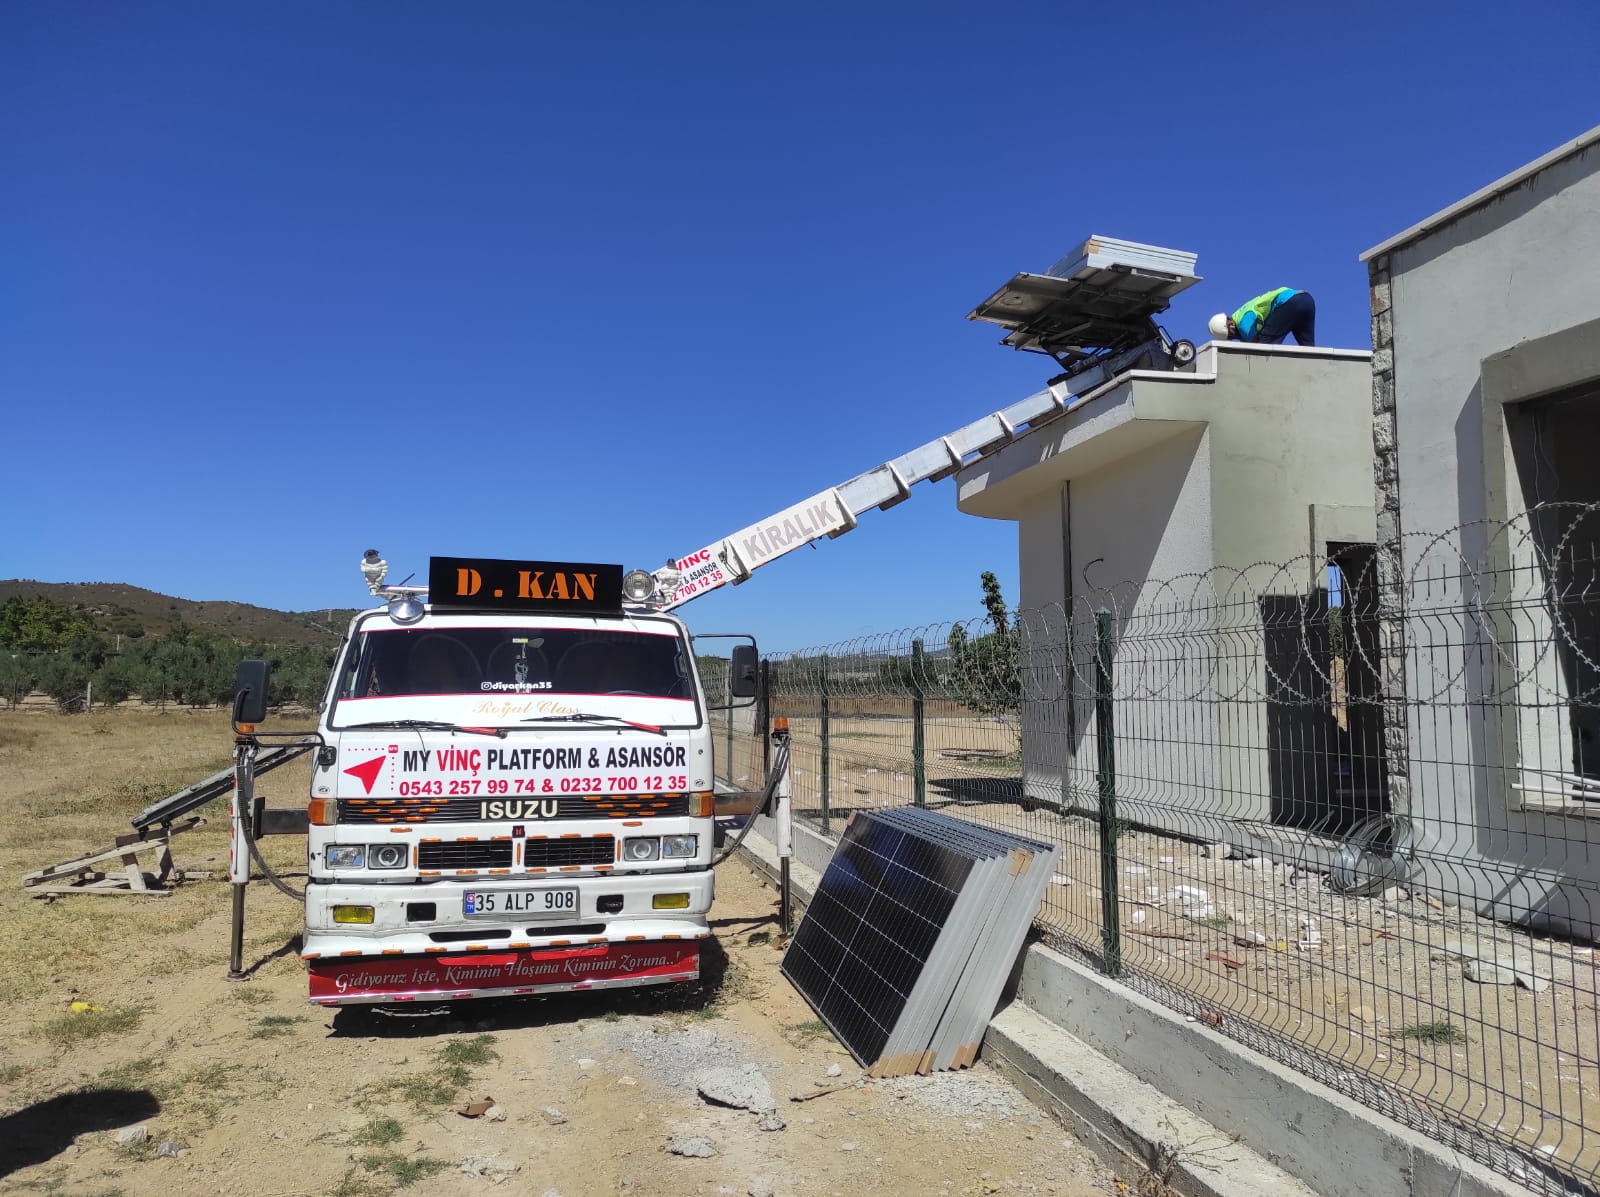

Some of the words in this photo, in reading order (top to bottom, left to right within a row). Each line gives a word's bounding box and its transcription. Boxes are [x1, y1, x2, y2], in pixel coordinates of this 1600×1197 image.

[742, 499, 837, 562] KİRALIK
[517, 570, 598, 601] KAN
[679, 583, 697, 598] 700
[698, 576, 711, 589] 12
[710, 570, 723, 582] 35
[472, 701, 533, 718] Royal
[536, 701, 583, 715] Class
[403, 749, 431, 772] MY
[436, 744, 482, 777] VİNÇ
[487, 747, 582, 771] PLATFORM
[587, 747, 600, 769] &
[606, 741, 687, 768] ASANSÖR
[399, 780, 443, 796] 0543
[448, 779, 482, 795] 257
[487, 779, 509, 794] 99
[514, 778, 536, 794] 74
[541, 778, 554, 793] &
[560, 777, 602, 792] 0232
[607, 776, 638, 791] 700
[643, 775, 663, 790] 12
[668, 775, 687, 790] 35
[480, 799, 558, 820] ISUZU
[475, 894, 495, 912] 35
[505, 892, 535, 911] ALP
[544, 891, 574, 909] 908
[335, 971, 407, 993] Gidiyoruz
[444, 964, 500, 985] Kiminin
[504, 958, 559, 978] Hoşuna
[563, 957, 617, 977] Kiminin
